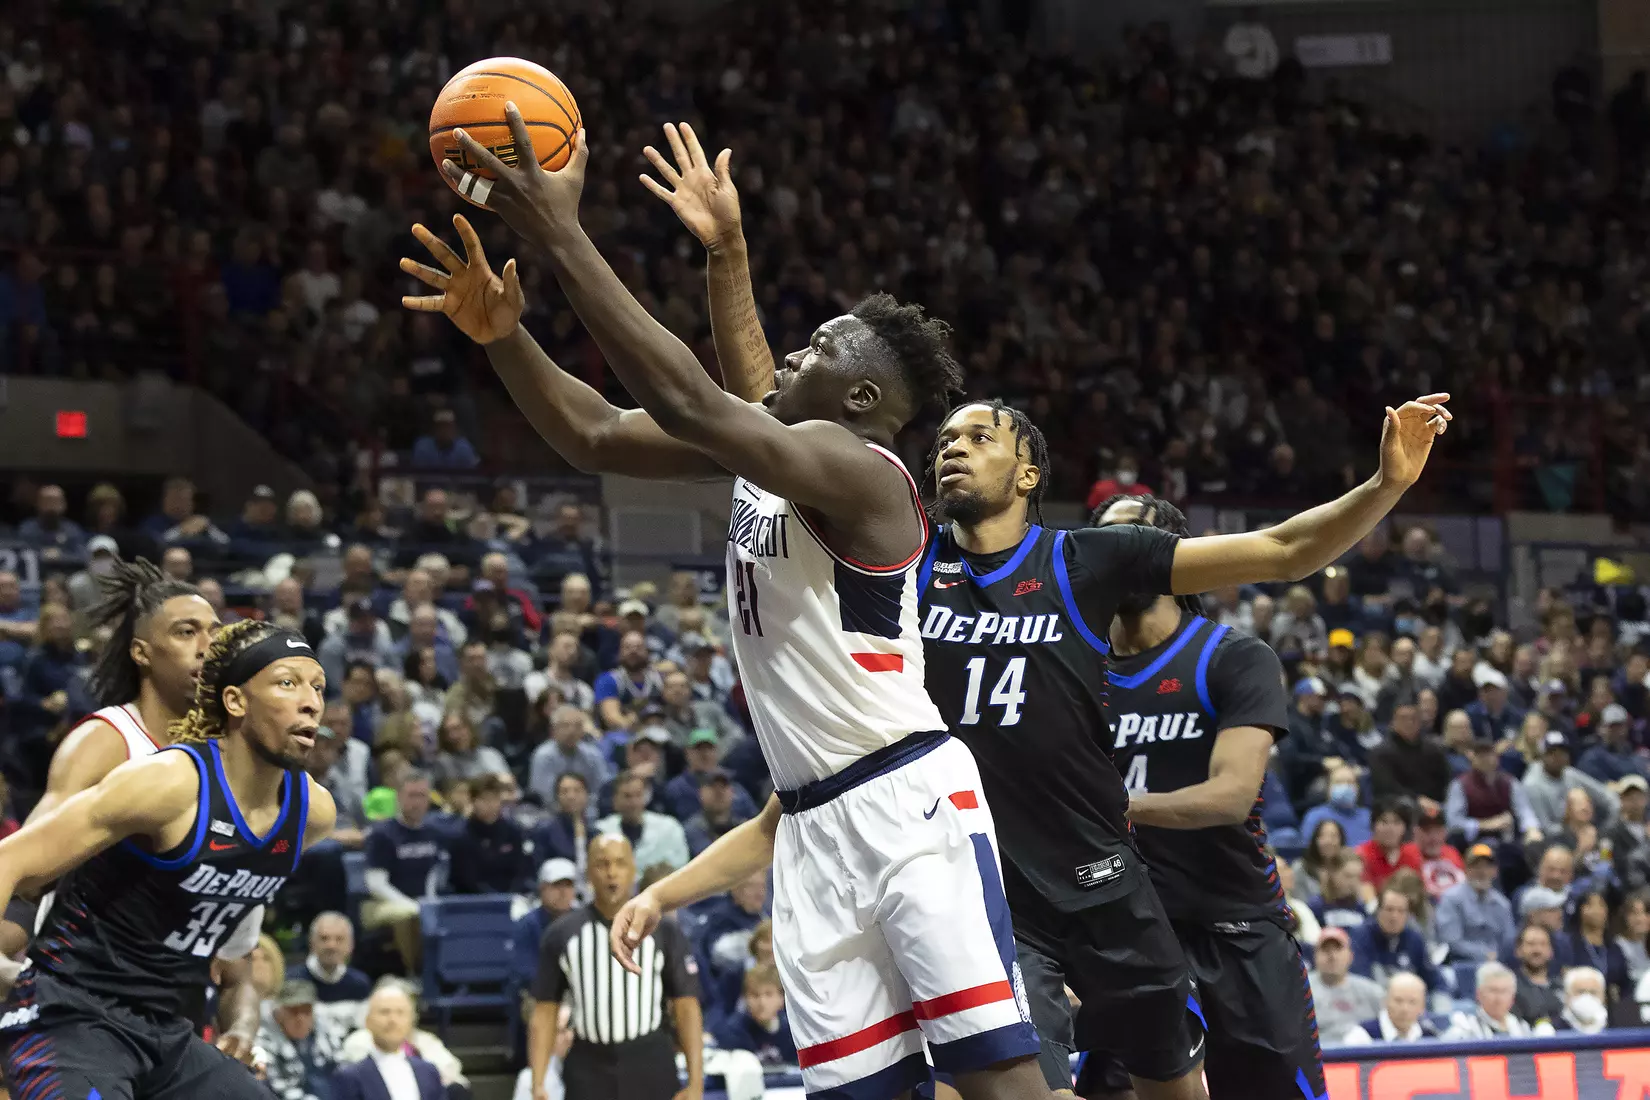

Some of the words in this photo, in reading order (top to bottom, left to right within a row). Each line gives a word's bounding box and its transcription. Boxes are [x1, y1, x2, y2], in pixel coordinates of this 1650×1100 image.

[736, 558, 764, 638] 21
[958, 655, 1027, 727] 14
[163, 900, 247, 958] 35
